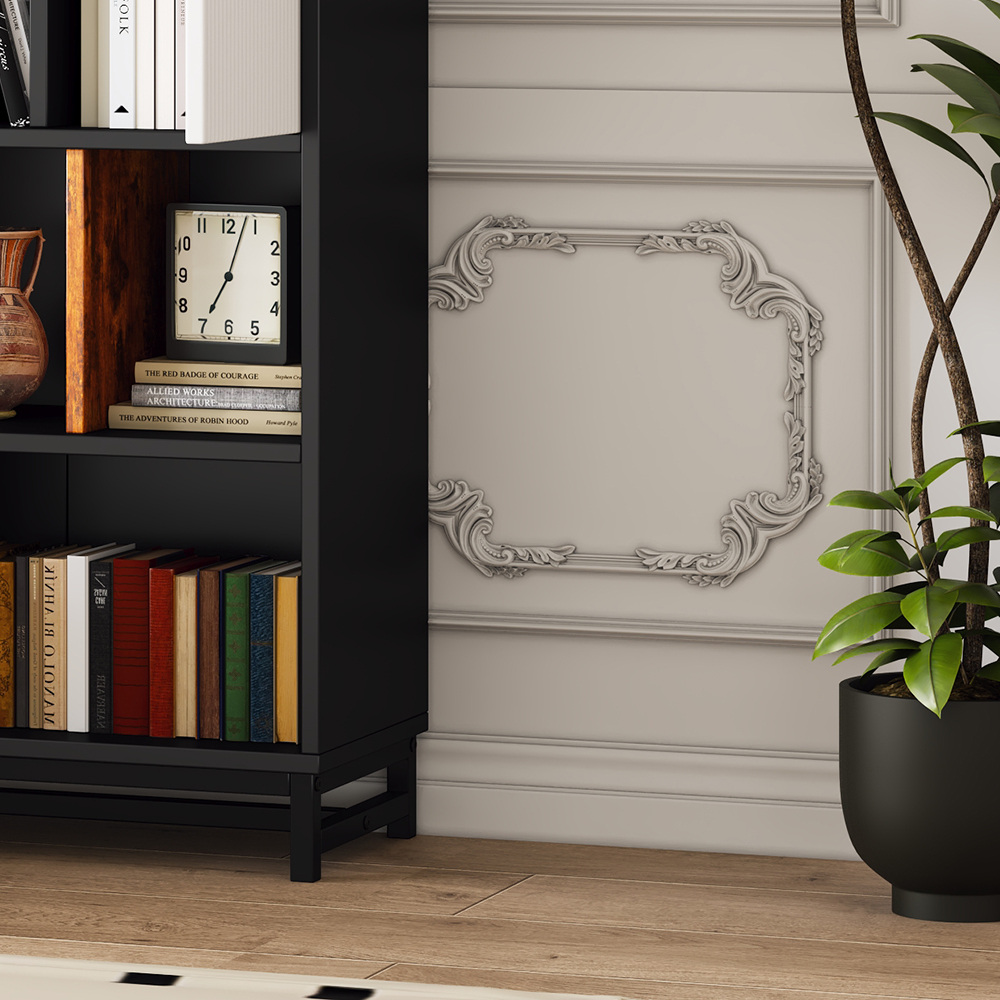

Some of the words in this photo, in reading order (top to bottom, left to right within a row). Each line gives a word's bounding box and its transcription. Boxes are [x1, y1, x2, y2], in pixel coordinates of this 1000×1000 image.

[198, 218, 206, 233] 11
[222, 218, 236, 234] 12
[254, 219, 257, 235] 1
[271, 241, 280, 256] 2
[178, 267, 187, 283] 9
[271, 271, 280, 286] 3
[179, 298, 188, 313] 8
[270, 301, 279, 316] 4
[198, 318, 207, 334] 7
[225, 319, 233, 335] 6
[250, 321, 259, 335] 5
[221, 372, 259, 380] COURAGE
[147, 387, 181, 396] ALLIED
[183, 389, 215, 397] WORKS
[135, 415, 186, 423] ADVENTURES
